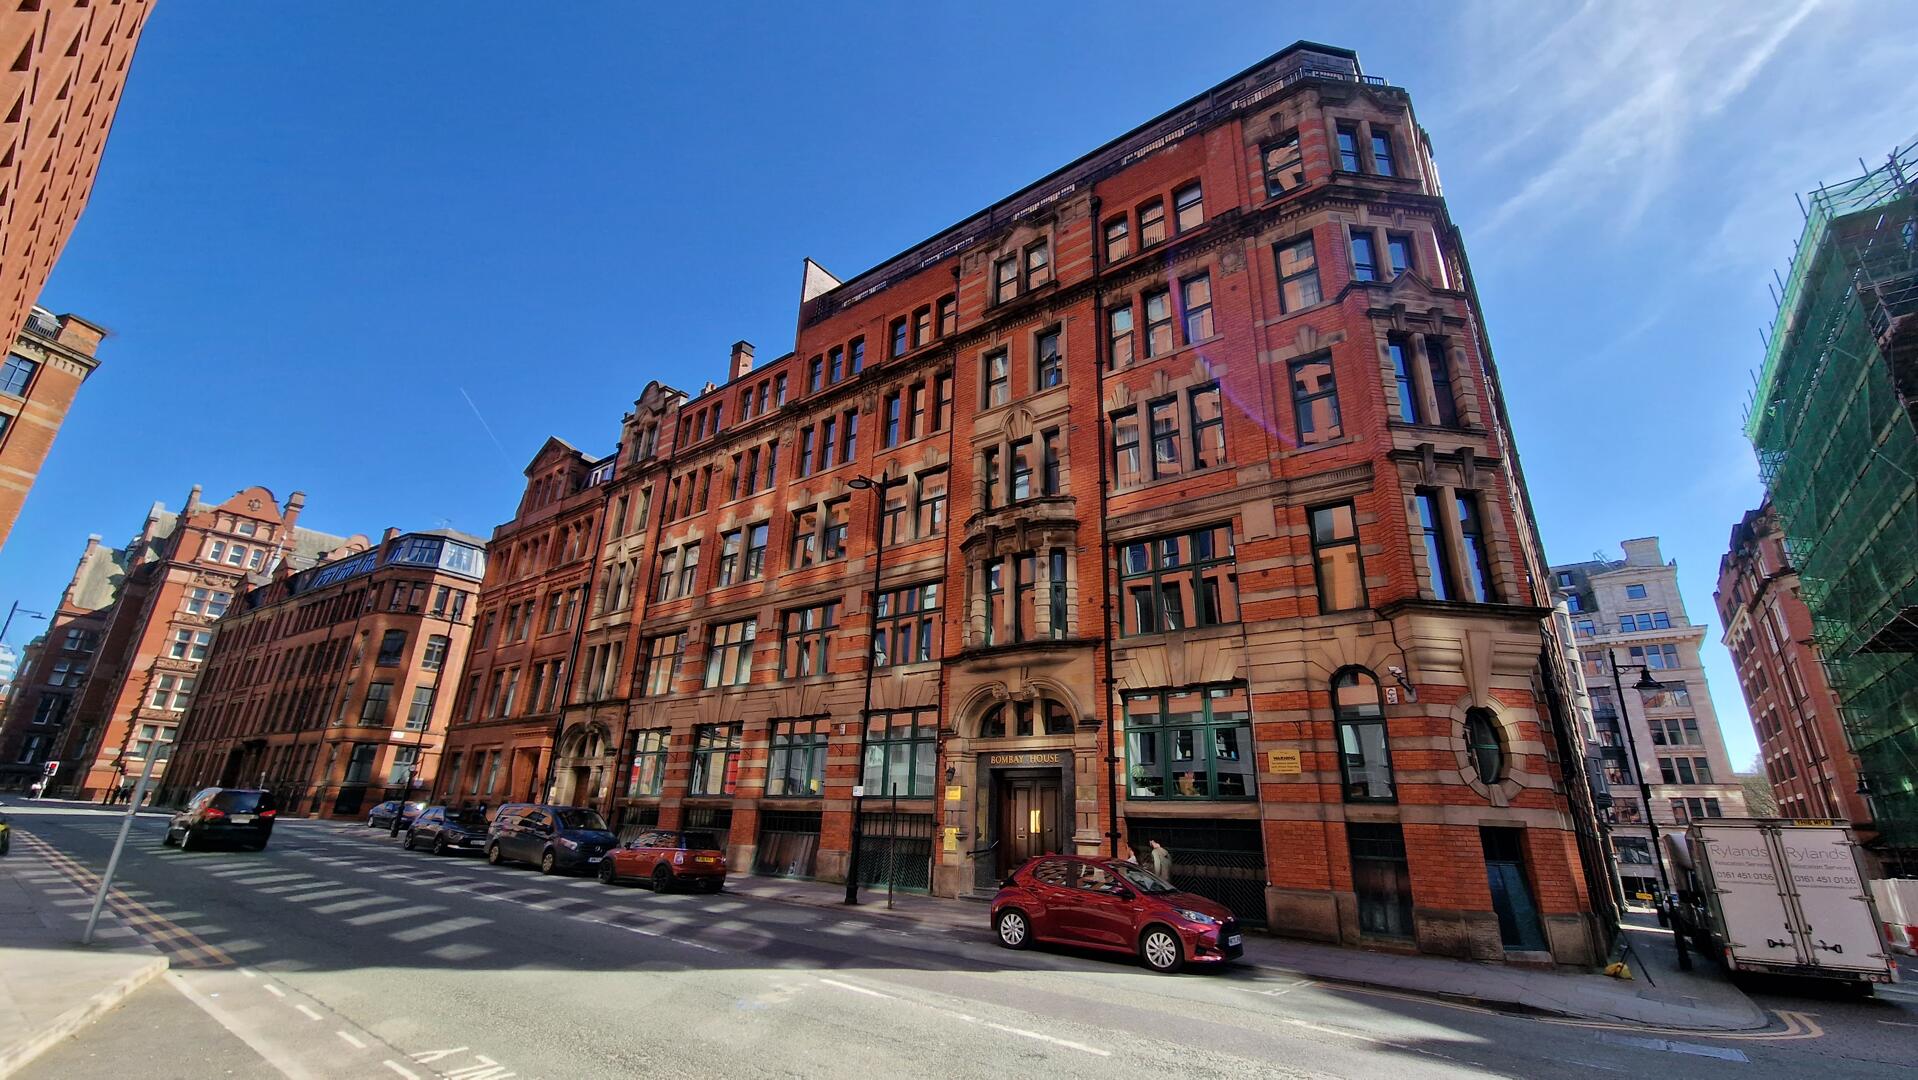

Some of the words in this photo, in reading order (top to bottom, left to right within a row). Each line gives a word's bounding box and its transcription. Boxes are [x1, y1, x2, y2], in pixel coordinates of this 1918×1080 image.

[990, 754, 1025, 764] BOMBAY
[1029, 753, 1060, 763] HOUSE
[1709, 844, 1769, 858] Rylands
[1785, 846, 1848, 861] Rylands
[1716, 871, 1735, 879] 0161
[1737, 872, 1751, 880] 451
[1753, 872, 1775, 881] 0136
[1794, 874, 1815, 883] 0161
[1816, 875, 1832, 884] 451
[1833, 876, 1857, 885] 0136
